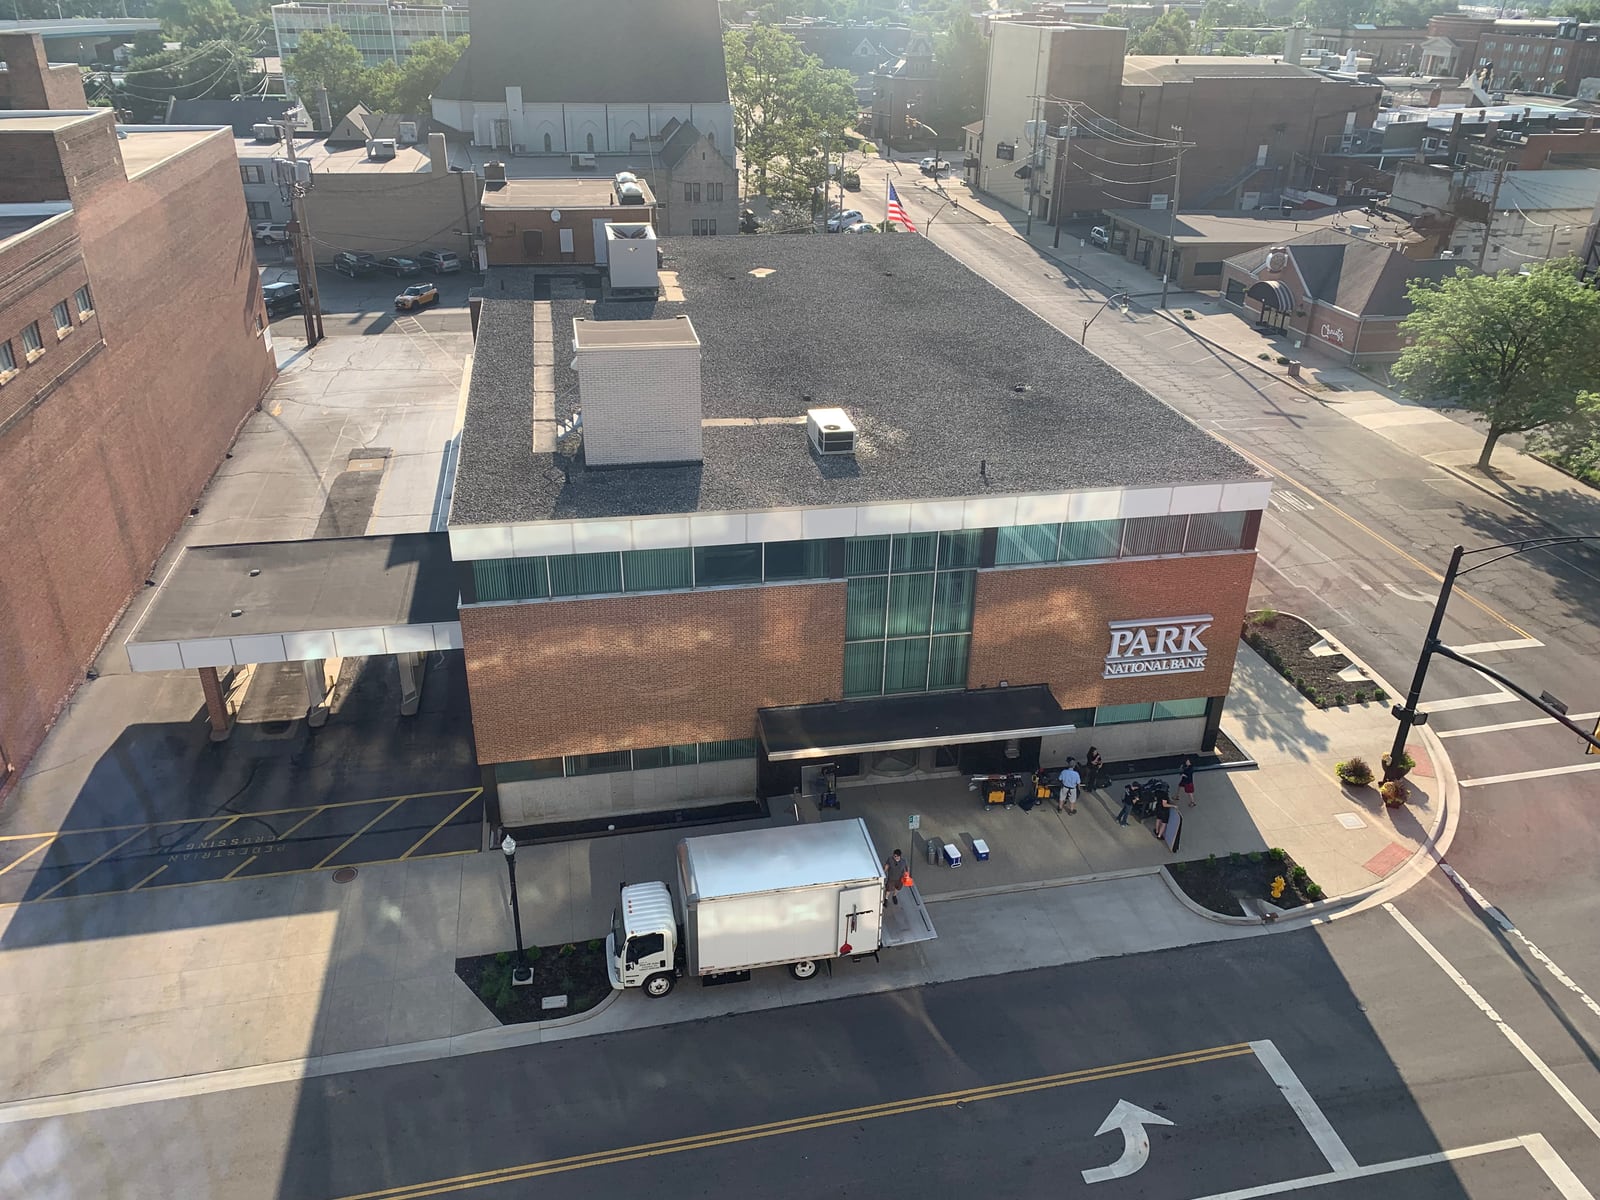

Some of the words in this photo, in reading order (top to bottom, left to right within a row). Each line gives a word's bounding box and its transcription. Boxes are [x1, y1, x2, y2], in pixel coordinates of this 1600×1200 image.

[1106, 623, 1211, 659] PARK
[1105, 660, 1170, 675] NATIONAL
[1170, 657, 1207, 670] BANK
[186, 835, 280, 850] CROSSING
[168, 844, 286, 863] PEDESTRIAN
